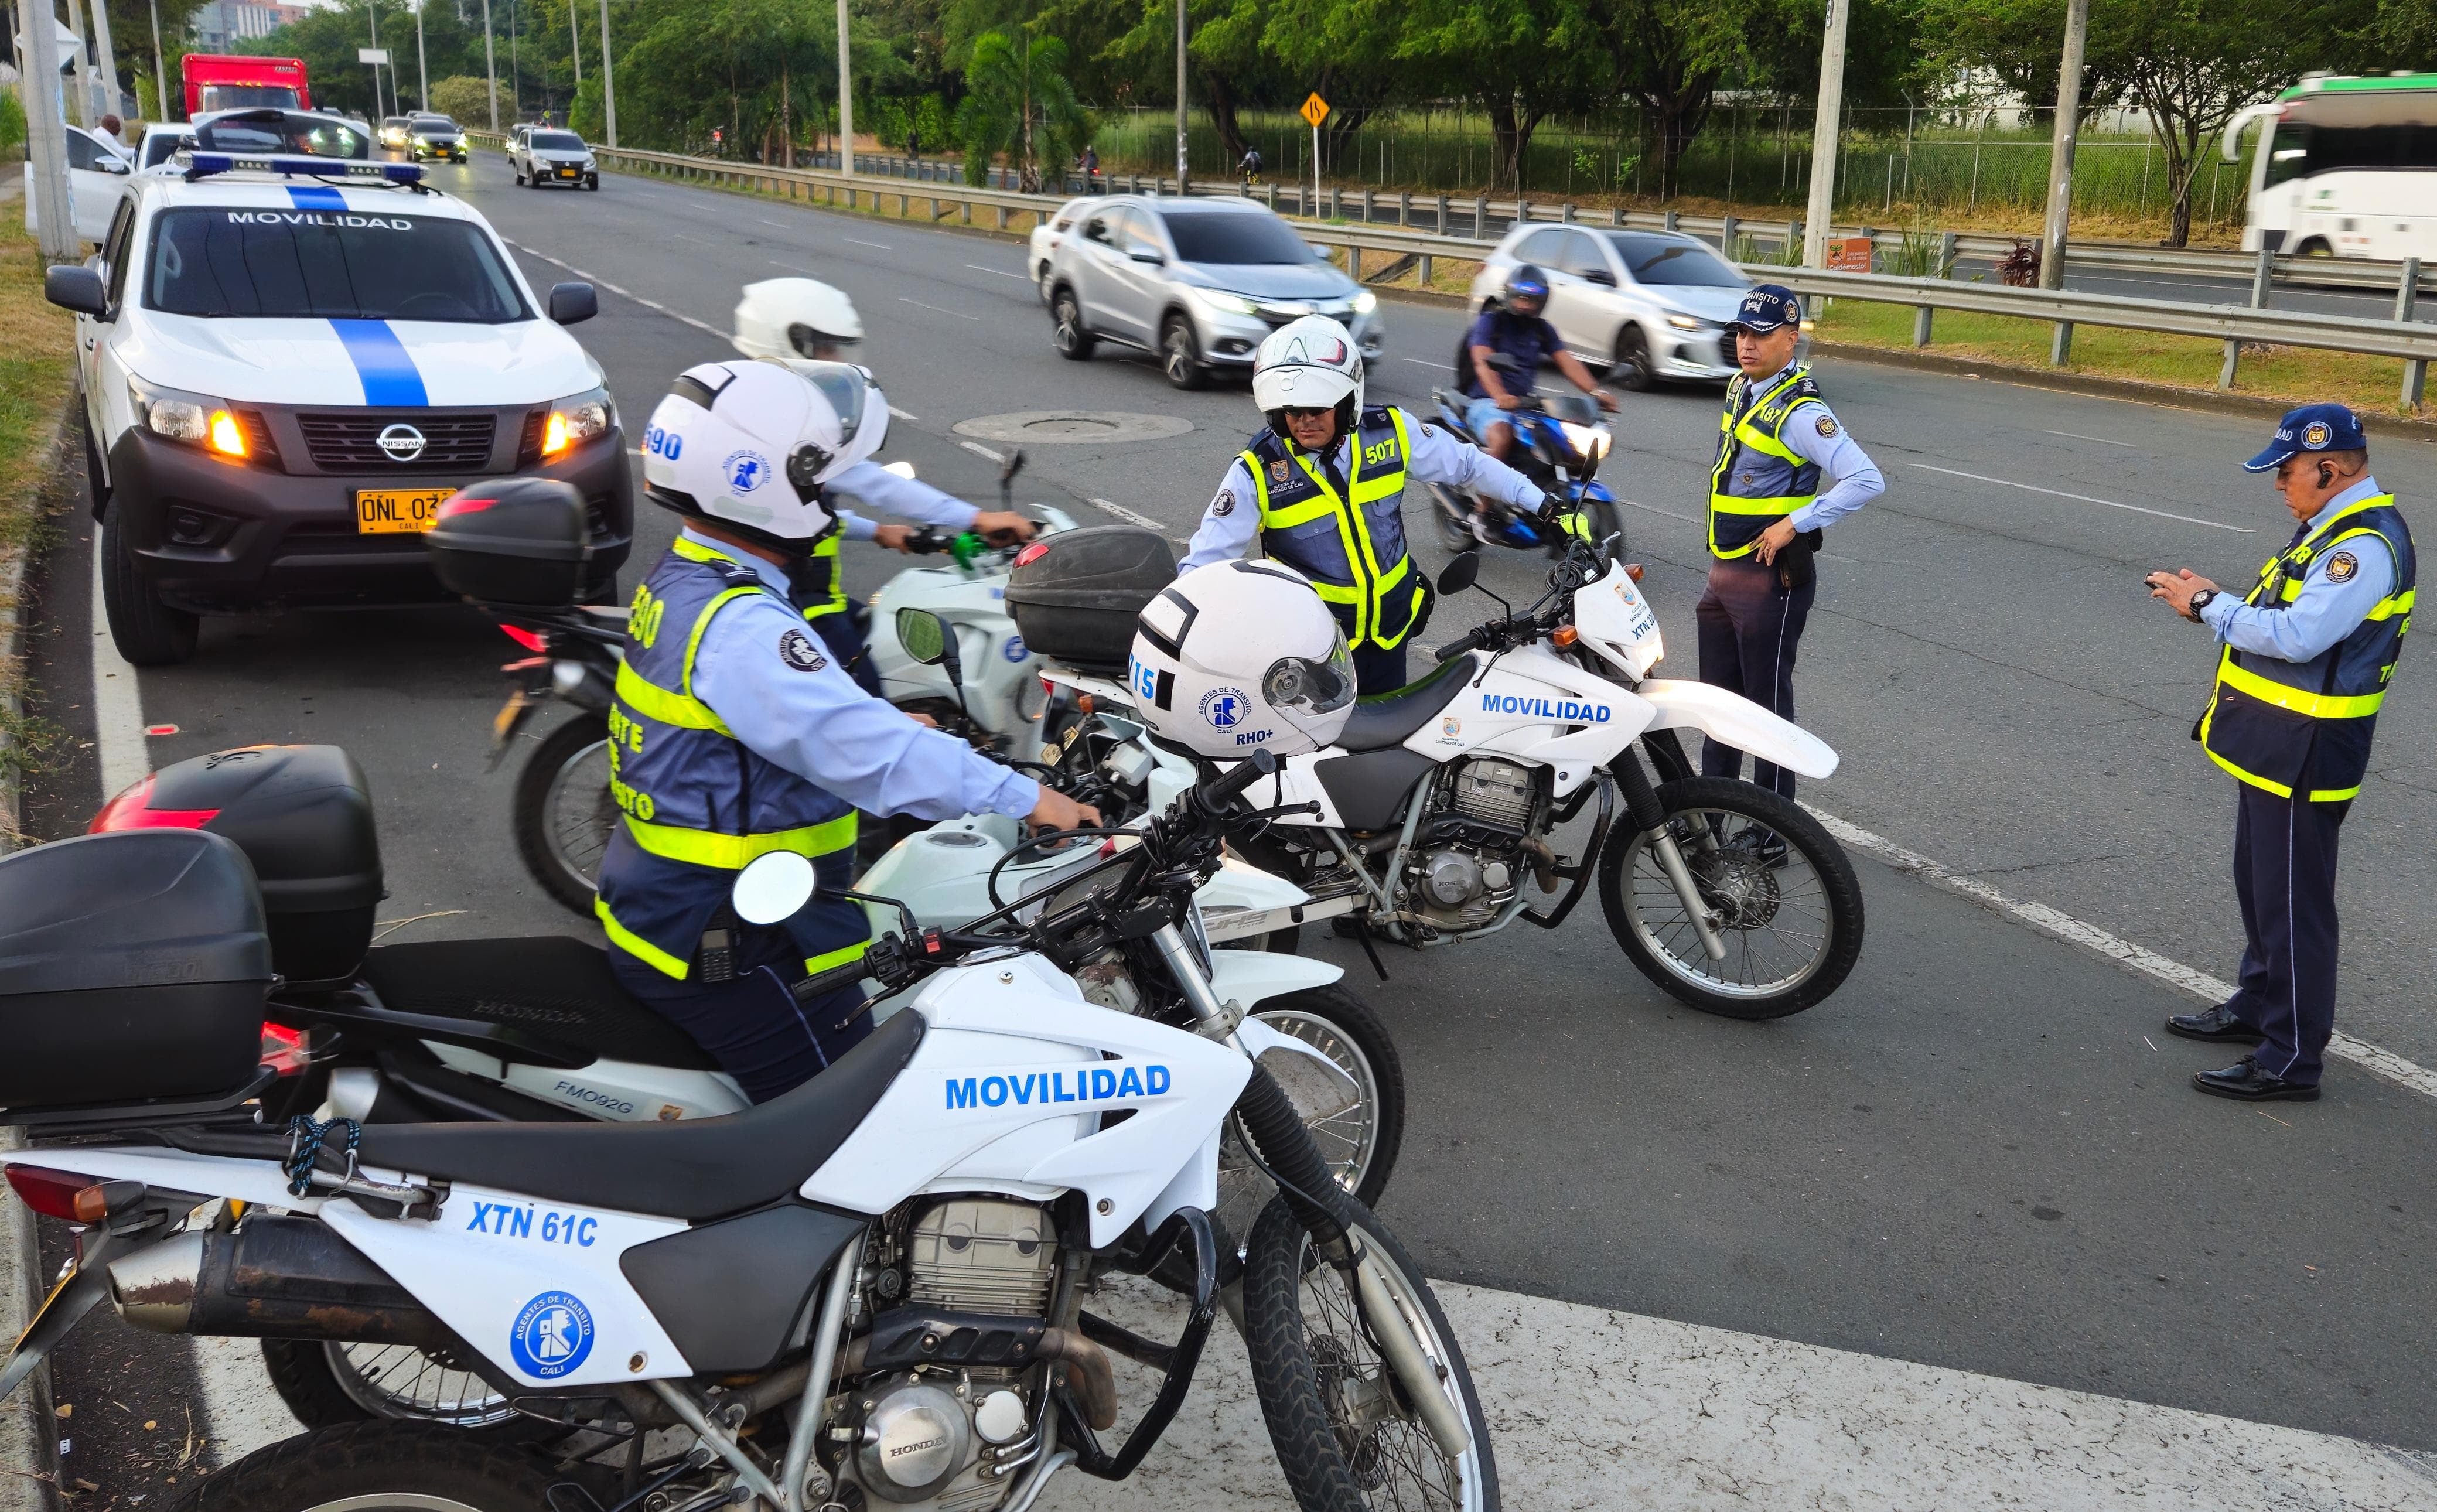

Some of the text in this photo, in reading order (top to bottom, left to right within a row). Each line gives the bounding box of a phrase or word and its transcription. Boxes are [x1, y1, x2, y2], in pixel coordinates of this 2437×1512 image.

[227, 212, 412, 230] MOVILIDAD
[1747, 292, 1779, 304] ANSITO
[1365, 438, 1395, 465] 507
[361, 497, 451, 521] ONL 03
[1632, 622, 1650, 640] XTN
[1199, 689, 1217, 714] AGENTES
[1231, 688, 1251, 714] TRANSITO
[1483, 694, 1611, 722] MOVILIDAD
[1237, 729, 1273, 745] RHO+
[946, 1065, 1170, 1109] MOVILIDAD
[467, 1202, 598, 1247] XTN 61C
[516, 1295, 591, 1340] AGENTES DE TRANSITO
[540, 1364, 564, 1375] CALI
[890, 1436, 947, 1458] HONDA
